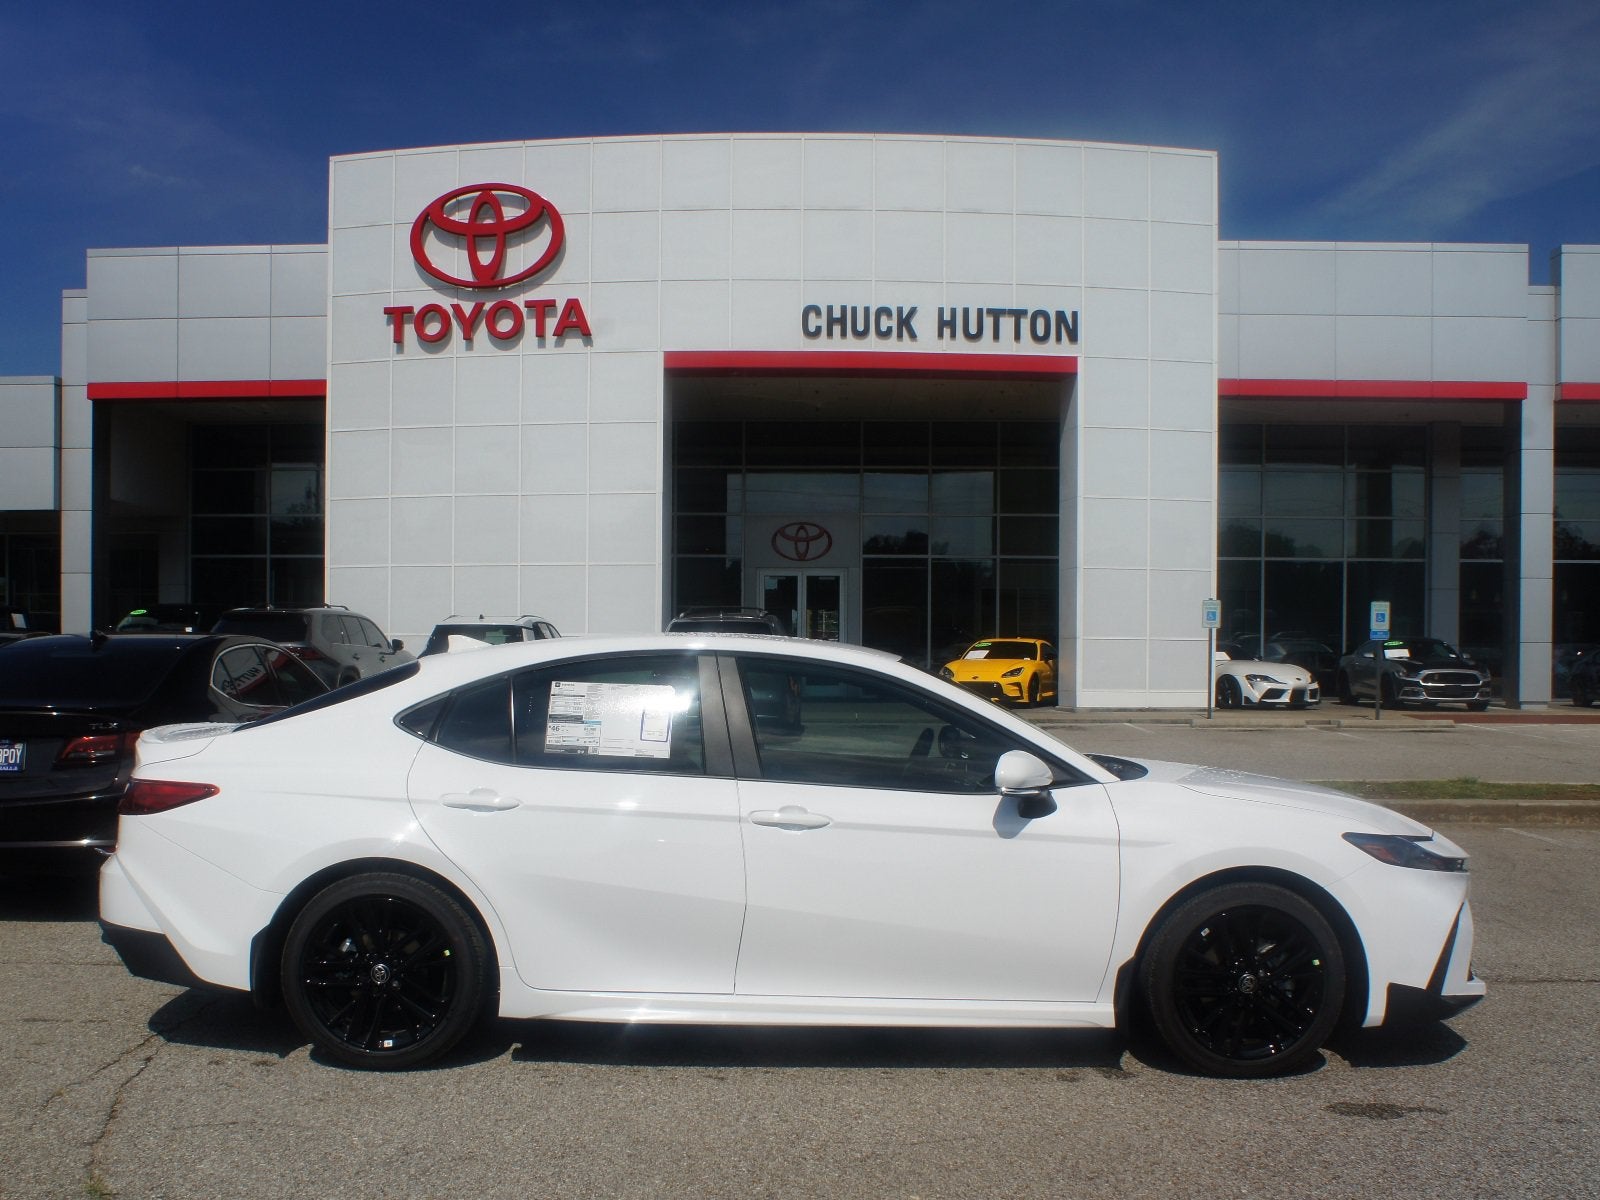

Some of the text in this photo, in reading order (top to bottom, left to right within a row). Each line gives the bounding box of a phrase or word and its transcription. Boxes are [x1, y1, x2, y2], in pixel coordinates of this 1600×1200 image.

[384, 298, 592, 344] TOYOTA
[802, 304, 1078, 344] CHUCK HUTTON
